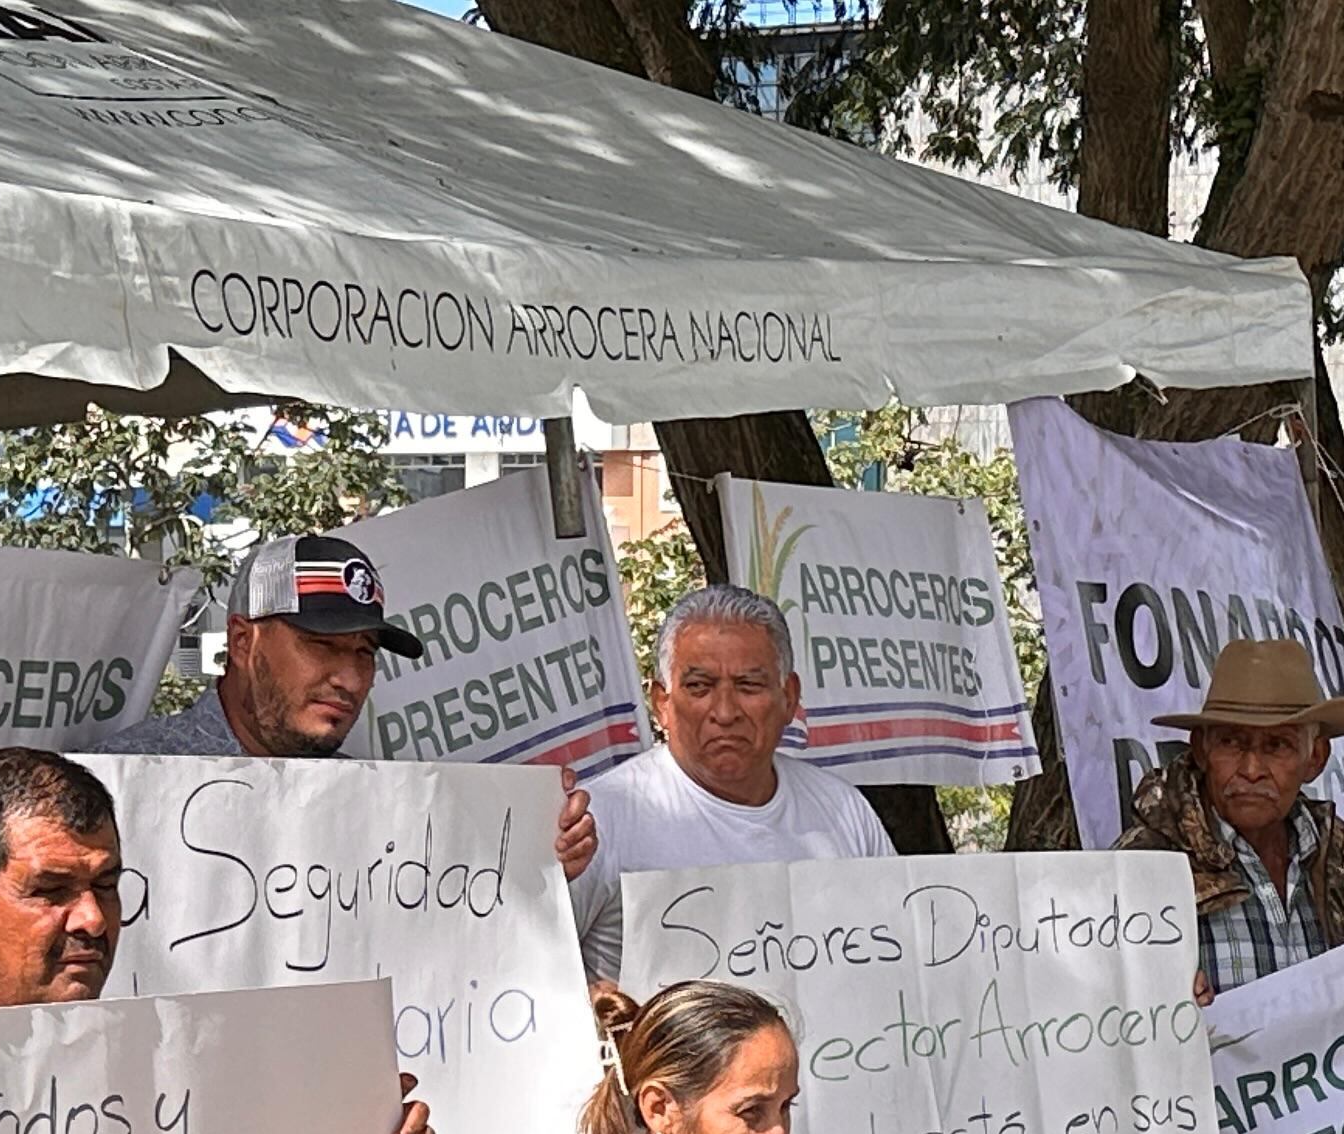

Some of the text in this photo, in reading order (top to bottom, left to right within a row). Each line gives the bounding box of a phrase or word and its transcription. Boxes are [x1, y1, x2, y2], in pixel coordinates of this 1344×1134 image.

[191, 269, 841, 363] CORPORACION ARROCERA NACIONAL
[421, 412, 457, 438] DE
[376, 549, 611, 681] RROCEROS
[799, 562, 995, 627] ARROCEROS
[377, 635, 605, 760] PRESENTES
[811, 636, 983, 697] PRESENTES
[120, 779, 511, 972] a Seguridad
[659, 884, 1183, 981] Señores Diputados
[395, 979, 537, 1063] aria
[810, 978, 1200, 1082] ector Arrocero
[1131, 1092, 1198, 1132] sus
